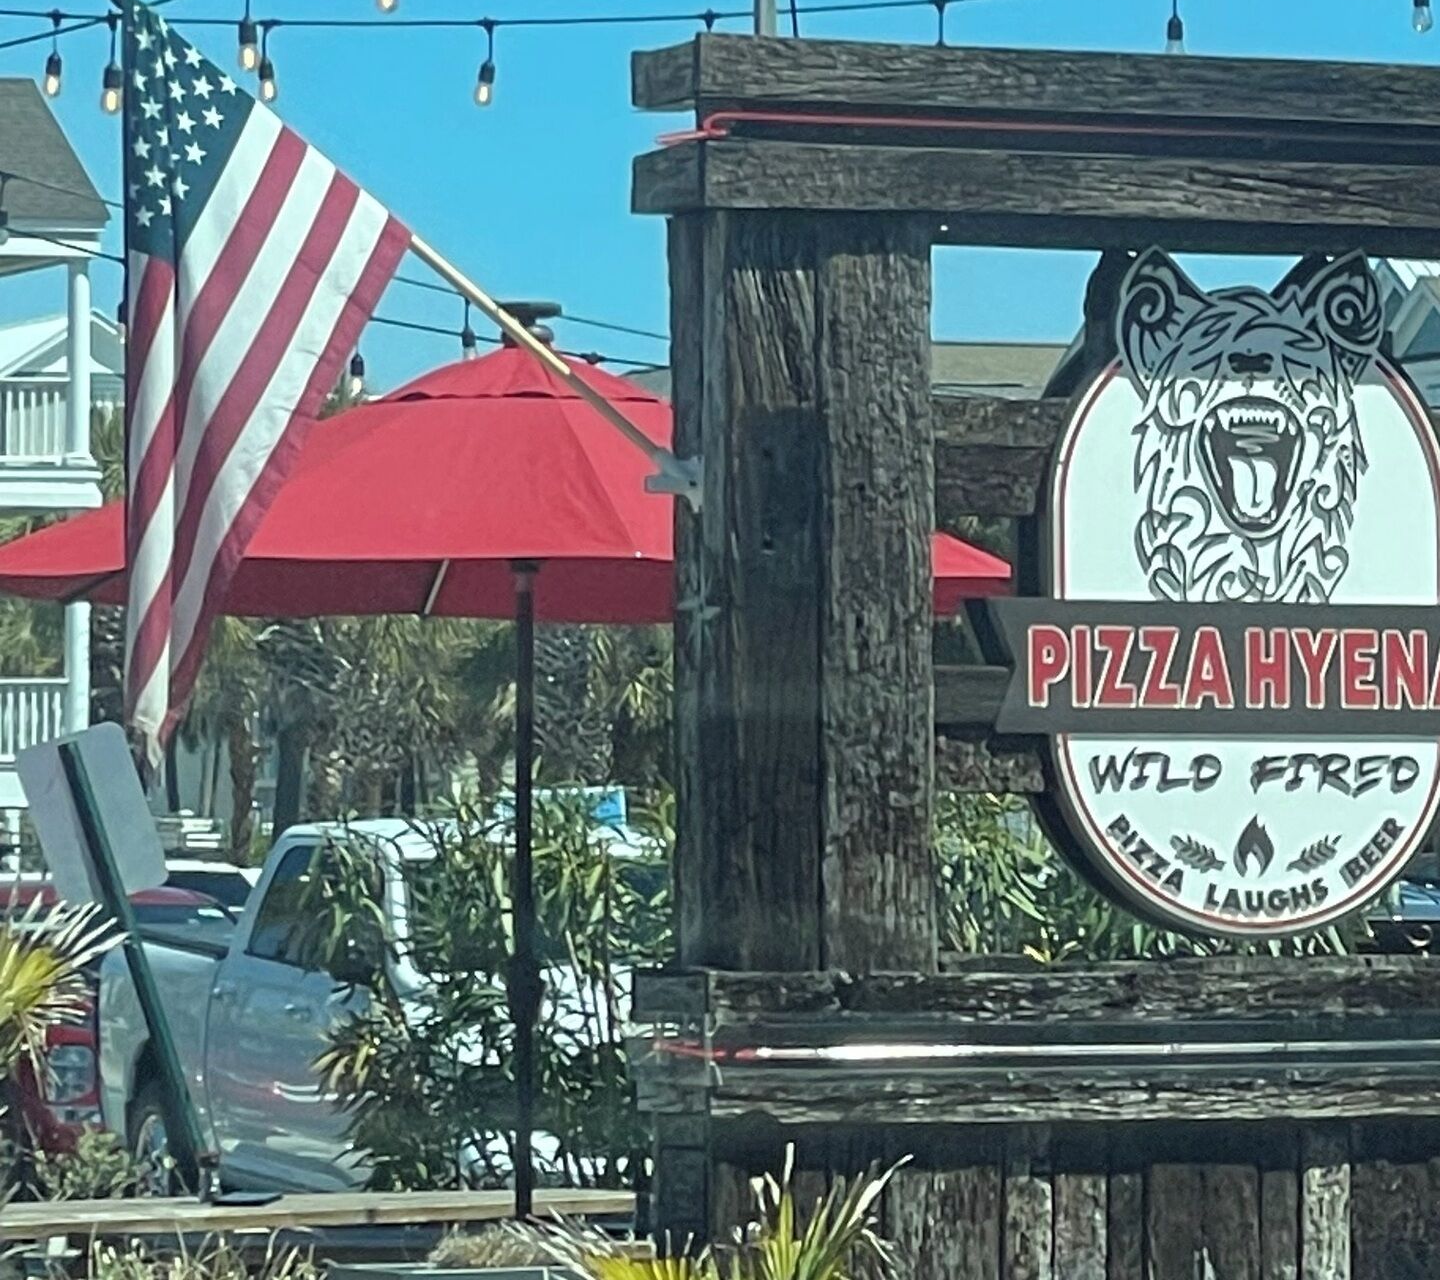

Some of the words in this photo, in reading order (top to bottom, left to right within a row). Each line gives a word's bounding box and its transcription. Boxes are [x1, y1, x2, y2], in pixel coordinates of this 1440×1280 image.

[1027, 625, 1234, 709] PIZZA
[1088, 747, 1222, 794] WILD
[1250, 752, 1421, 798] FIRED
[1106, 814, 1184, 895] PIZZA
[1203, 878, 1330, 917] LAUGHS
[1338, 817, 1406, 891] BEER
